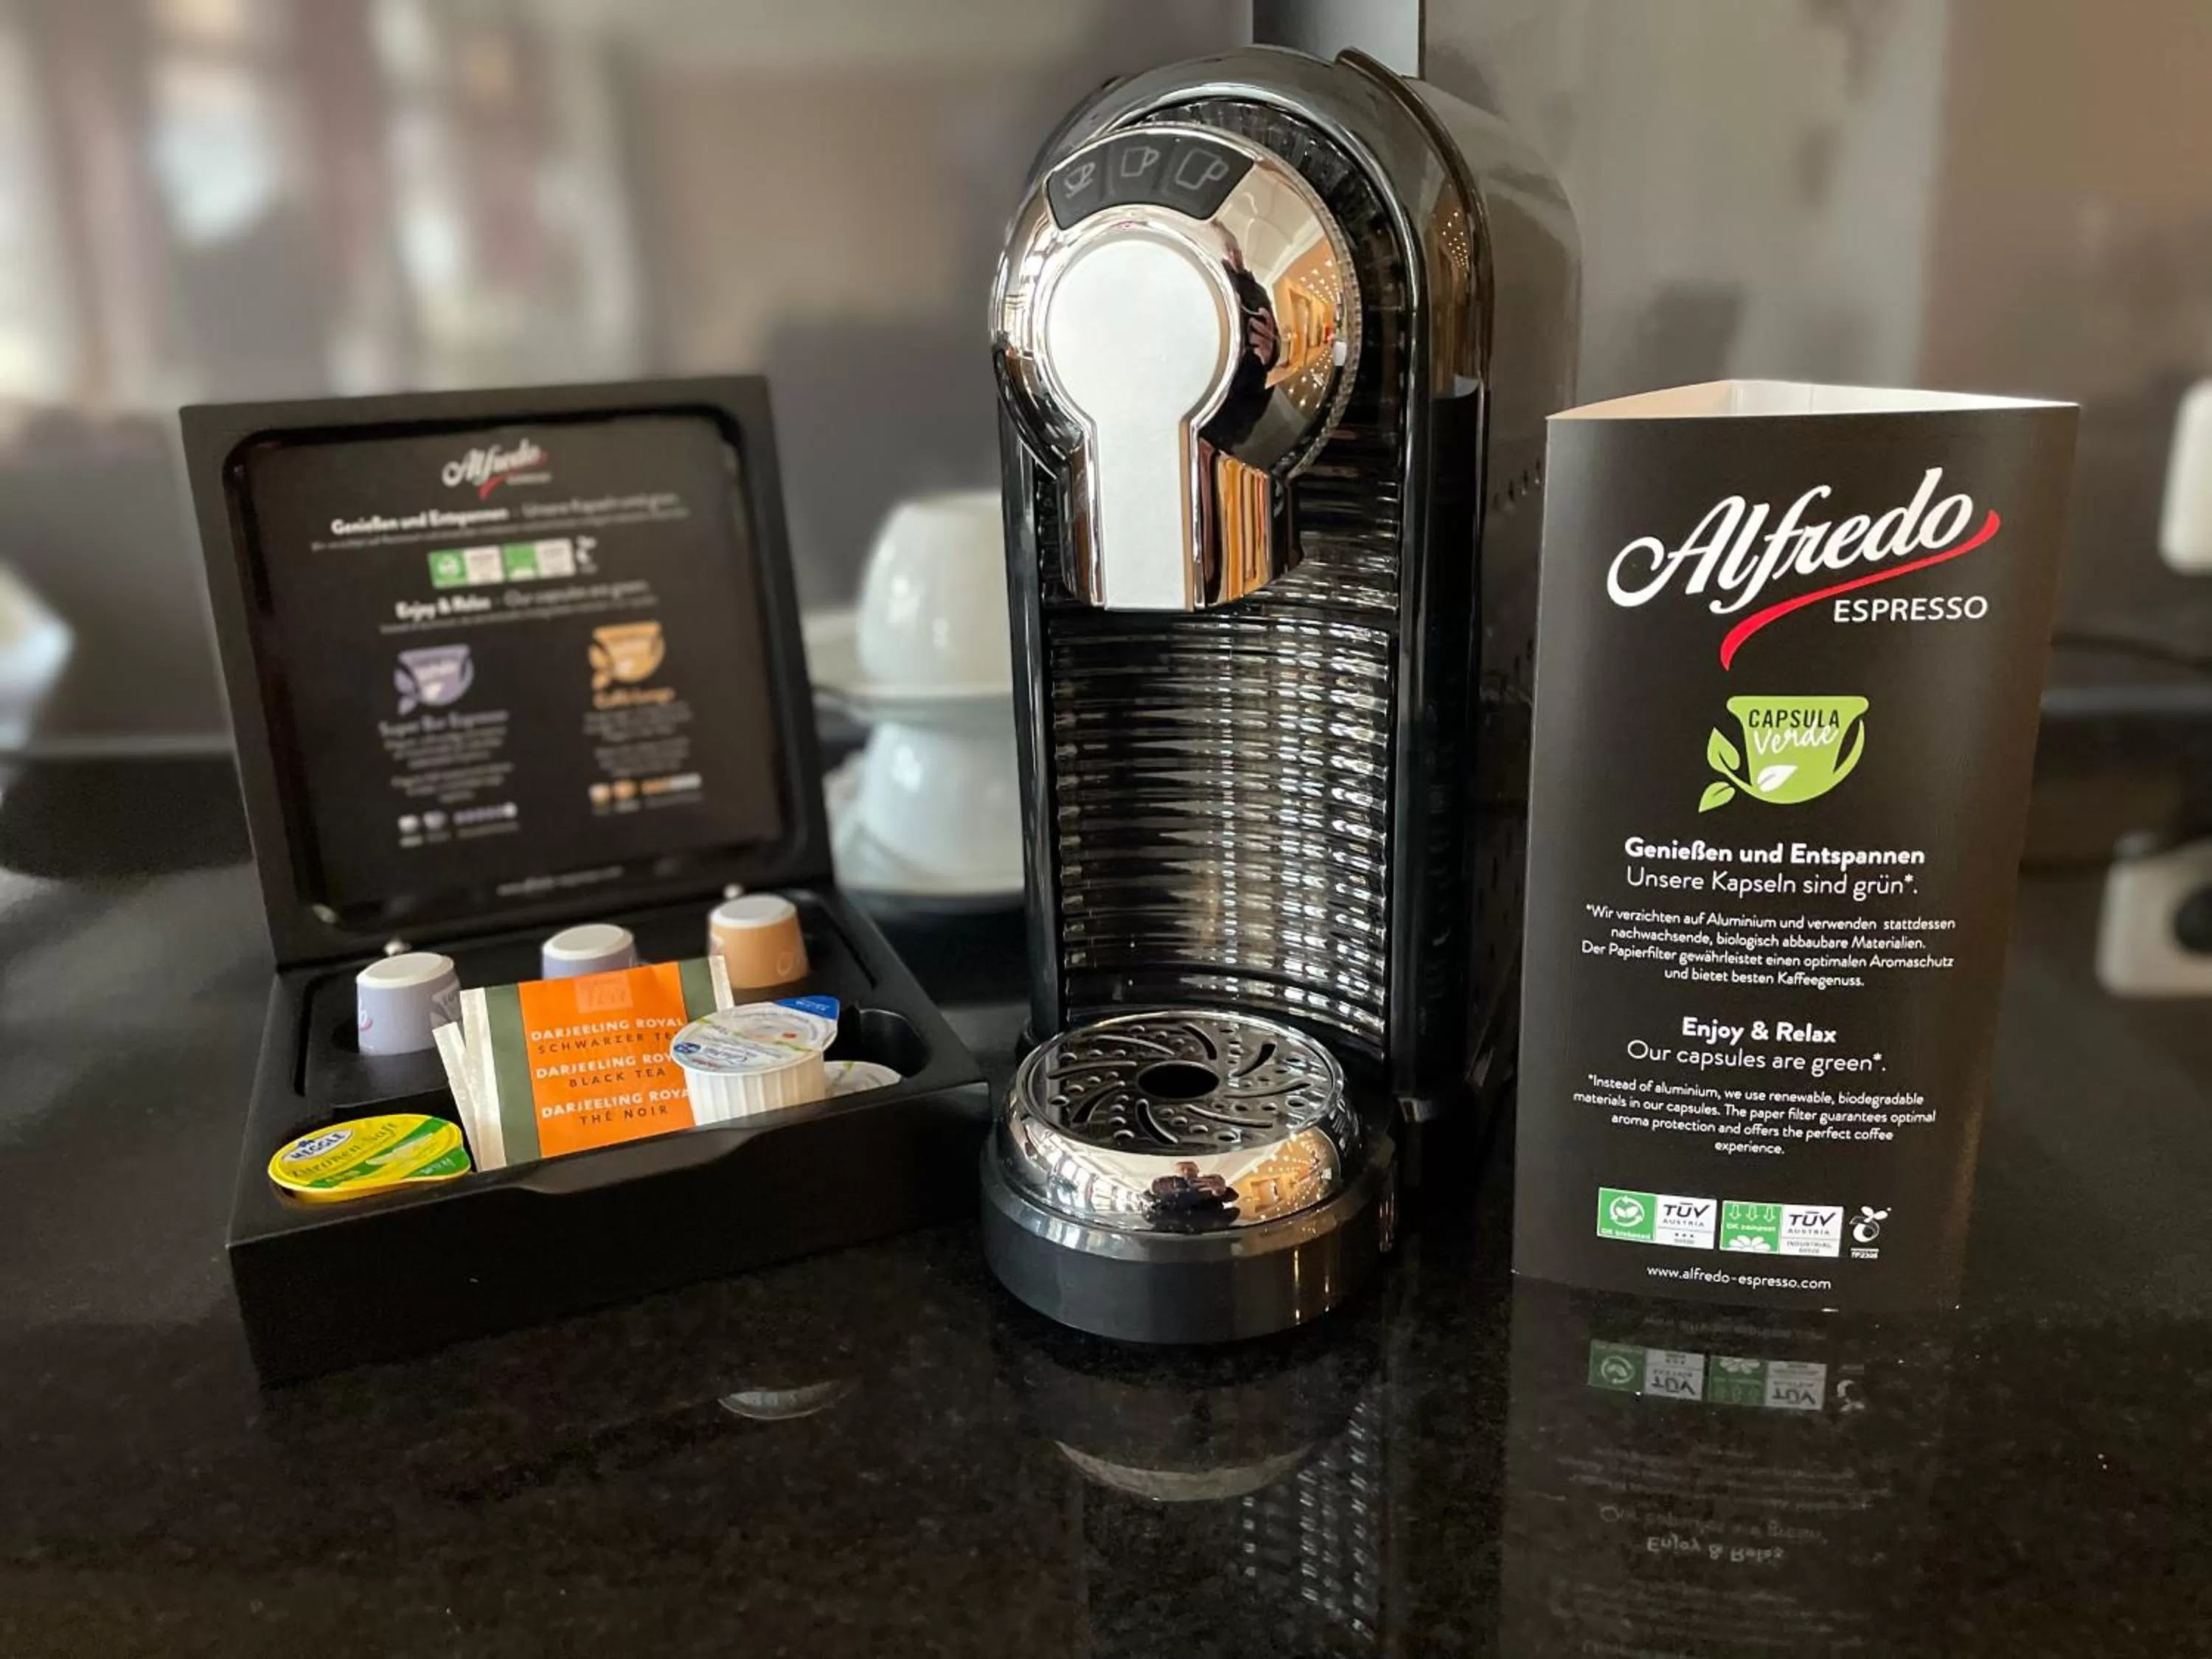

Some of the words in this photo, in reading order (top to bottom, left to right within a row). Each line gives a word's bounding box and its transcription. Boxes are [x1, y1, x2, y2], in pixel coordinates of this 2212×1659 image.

[1607, 467, 1973, 614] Alfredo
[1833, 596, 1987, 622] ESPRESSO
[1748, 709, 1840, 728] CAPSULA
[1753, 718, 1840, 756] Verde
[1624, 836, 1733, 862] Genießen
[1739, 842, 1784, 863] und
[1790, 842, 1925, 872] Entspannen
[1627, 865, 1704, 890] Unsere
[1711, 870, 1796, 899] Kapseln
[1804, 872, 1847, 894] sind
[1616, 908, 1680, 923] verzichten
[1683, 912, 1705, 925] auf
[1706, 912, 1777, 928] Aluminium
[1779, 914, 1804, 929] und
[1807, 917, 1877, 930] verwenden
[1883, 915, 1956, 931] stattdessen
[1611, 925, 1713, 946] nachwachsende,
[1717, 931, 1779, 950] biologisch
[1782, 934, 1848, 949] abbaubare
[1851, 935, 1926, 950] Materialien.
[1582, 940, 1606, 954] Der
[1608, 942, 1677, 961] Papierfilter
[1679, 949, 1763, 966] gewährleistet
[1766, 953, 1801, 966] einen
[1804, 954, 1867, 970] optimalen
[1869, 953, 1954, 968] Aromaschutz
[1664, 967, 1689, 979] und
[1691, 968, 1729, 982] bietet
[1731, 970, 1774, 984] besten
[1778, 971, 1865, 990] Kaffeegenuss.
[531, 1019, 630, 1042] DARJEELING
[538, 1033, 644, 1054] SCHWARZER
[655, 1032, 678, 1041] TE
[1682, 1016, 1744, 1046] Enjoy
[1750, 1020, 1769, 1041] &
[1776, 1021, 1837, 1043] Relax
[536, 1055, 637, 1079] DARJEELING
[1627, 1039, 1672, 1061] Our
[1677, 1048, 1767, 1071] capsules
[1772, 1054, 1806, 1069] are
[568, 1072, 625, 1088] BLACK
[636, 1067, 667, 1079] TEA
[542, 1092, 644, 1119] DARJEELING
[649, 1088, 690, 1102] ROYA
[1639, 1080, 1654, 1092] of
[1655, 1082, 1722, 1100] aluminium,
[1724, 1090, 1742, 1099] we
[1745, 1091, 1766, 1101] use
[1769, 1091, 1835, 1105] renewable,
[1838, 1091, 1924, 1109] biodegradable
[624, 1105, 669, 1119] NOIR
[1573, 1092, 1627, 1107] materials
[1629, 1096, 1641, 1108] in
[1643, 1100, 1663, 1110] our
[1666, 1102, 1721, 1116] capsules.
[1724, 1103, 1746, 1117] The
[1750, 1109, 1785, 1122] paper
[1788, 1107, 1818, 1121] filter
[1820, 1111, 1887, 1126] guarantees
[1890, 1110, 1937, 1127] optimal
[1611, 1114, 1649, 1127] aroma
[1652, 1118, 1716, 1131] protection
[1718, 1122, 1741, 1135] and
[1744, 1123, 1779, 1137] offers
[1782, 1124, 1804, 1138] the
[1806, 1126, 1851, 1142] perfect
[1854, 1127, 1893, 1141] coffee
[1714, 1141, 1785, 1155] experience.
[1663, 1201, 1711, 1218] TÜV
[1789, 1211, 1837, 1227] TÜV
[1662, 1218, 1705, 1228] AUSTRIA
[1787, 1228, 1830, 1236] AUSTRIA
[1646, 1265, 1832, 1290] www.alfredo-espresso.com
